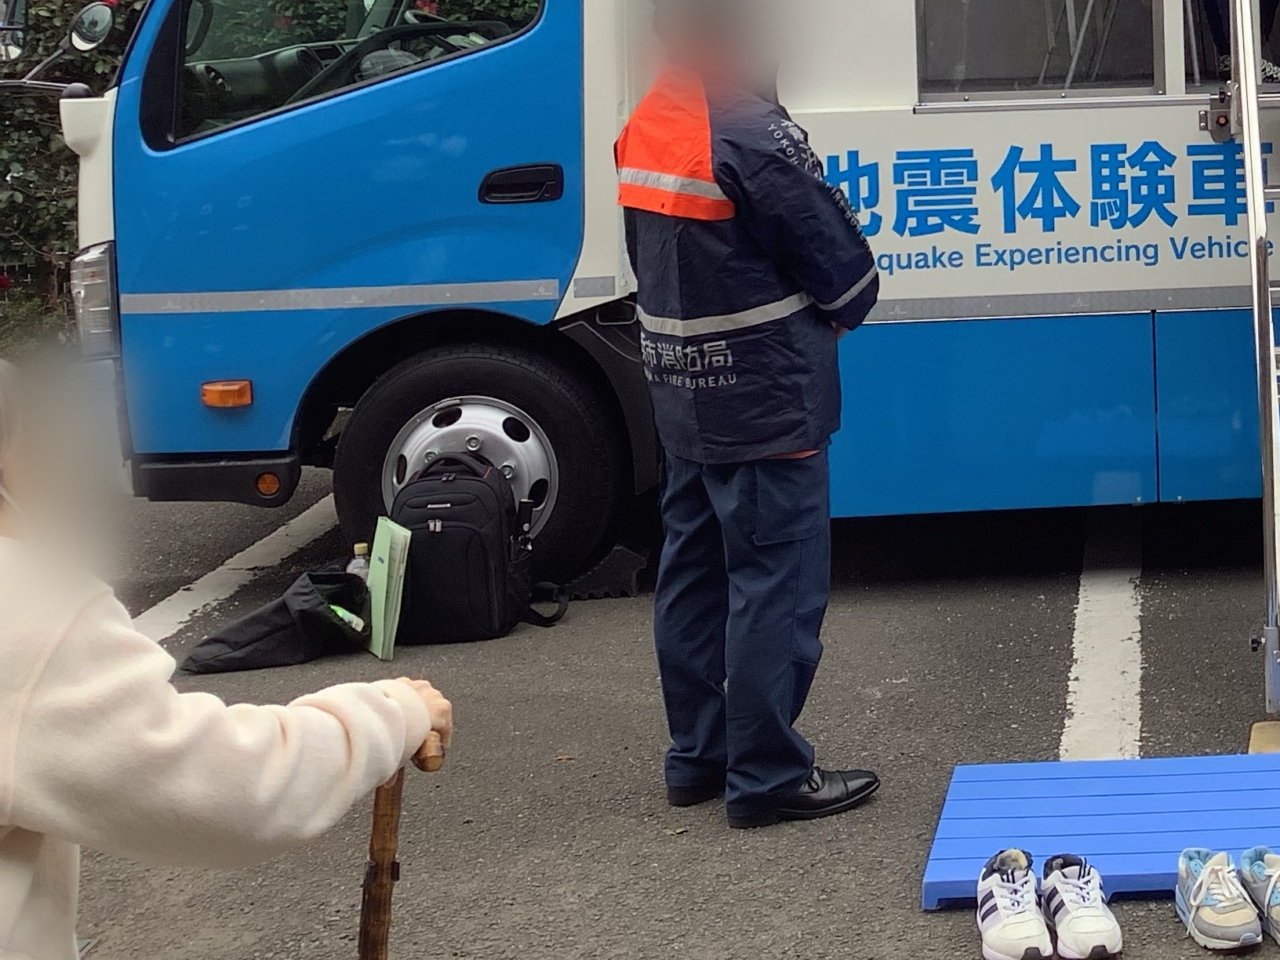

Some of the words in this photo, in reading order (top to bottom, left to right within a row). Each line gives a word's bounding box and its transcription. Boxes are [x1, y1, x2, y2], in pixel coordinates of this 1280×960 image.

[975, 238, 1159, 271] Experiencing
[1169, 235, 1274, 260] Vehice
[641, 332, 733, 371] 市消防局
